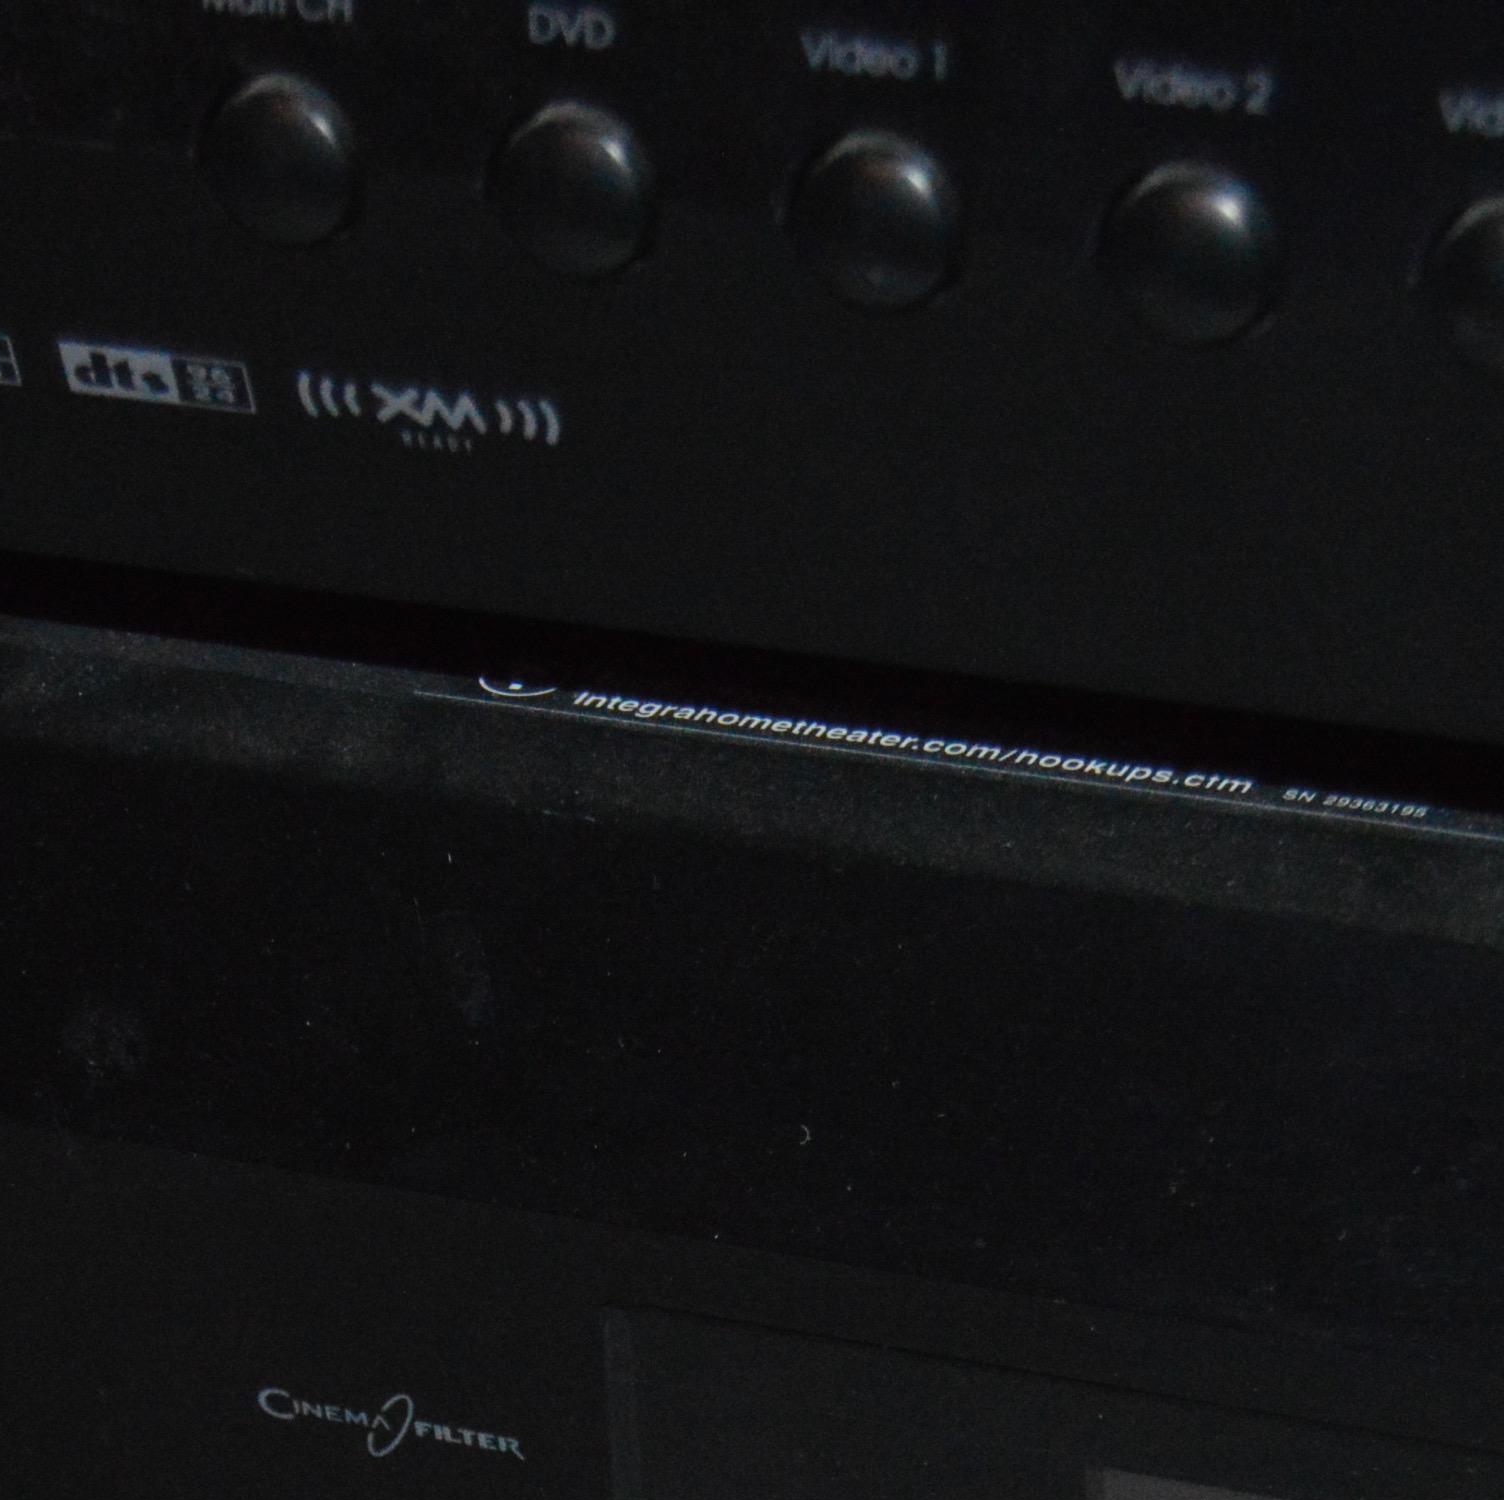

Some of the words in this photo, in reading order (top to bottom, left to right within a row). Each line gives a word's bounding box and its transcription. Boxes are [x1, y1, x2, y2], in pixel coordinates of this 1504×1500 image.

[527, 4, 615, 48] DVD
[799, 30, 920, 80] Video
[933, 42, 948, 81] 1
[1112, 60, 1238, 112] Video
[1245, 69, 1274, 116] 2
